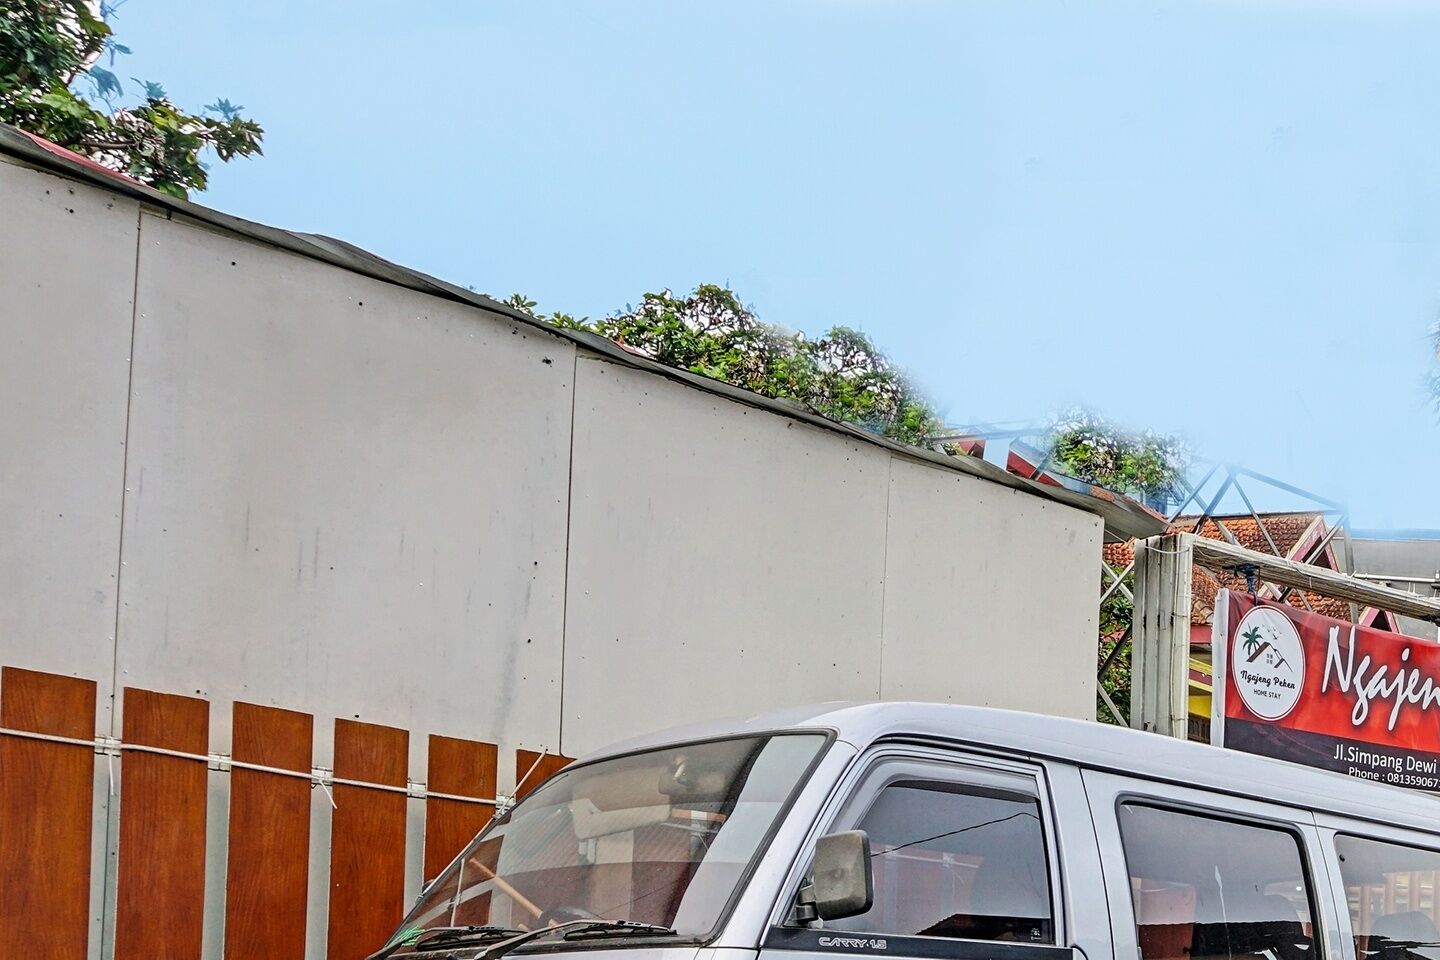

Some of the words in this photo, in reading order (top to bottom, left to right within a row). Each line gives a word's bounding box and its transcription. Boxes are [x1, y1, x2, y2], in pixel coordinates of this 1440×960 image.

[1240, 669, 1271, 688] Ngajeng
[1273, 676, 1296, 690] Peken
[1253, 688, 1269, 699] HOME
[1268, 691, 1282, 700] STAY
[1348, 766, 1379, 781] Phone
[1406, 756, 1437, 775] Dewi
